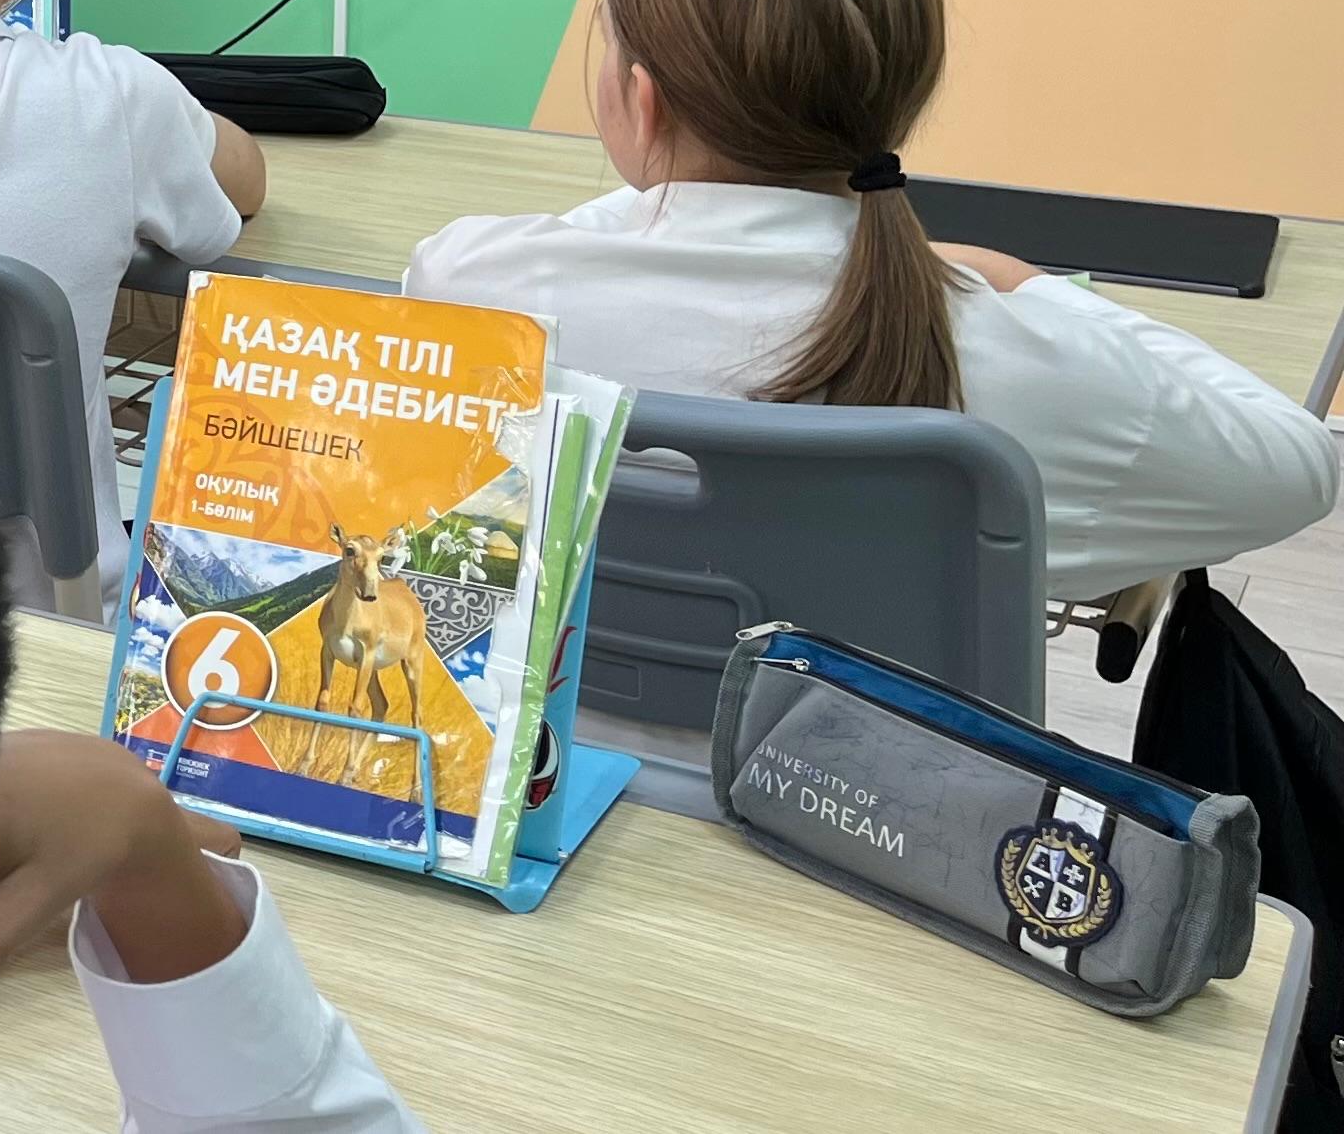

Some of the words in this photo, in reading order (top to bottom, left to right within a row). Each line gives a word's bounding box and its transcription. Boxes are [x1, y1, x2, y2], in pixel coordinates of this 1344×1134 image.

[221, 313, 360, 370] ҚАЗАҚ
[374, 334, 454, 377] ТІЛІ
[213, 358, 299, 400] МЕН
[203, 414, 365, 461] БӘЙШЕШЕК
[192, 499, 255, 524] 1-БӨЛІМ
[195, 473, 280, 506] ОҚУЛЫҚ
[188, 628, 240, 709] 6
[748, 763, 792, 799] MY
[800, 786, 905, 857] DREAM
[855, 789, 879, 808] OF
